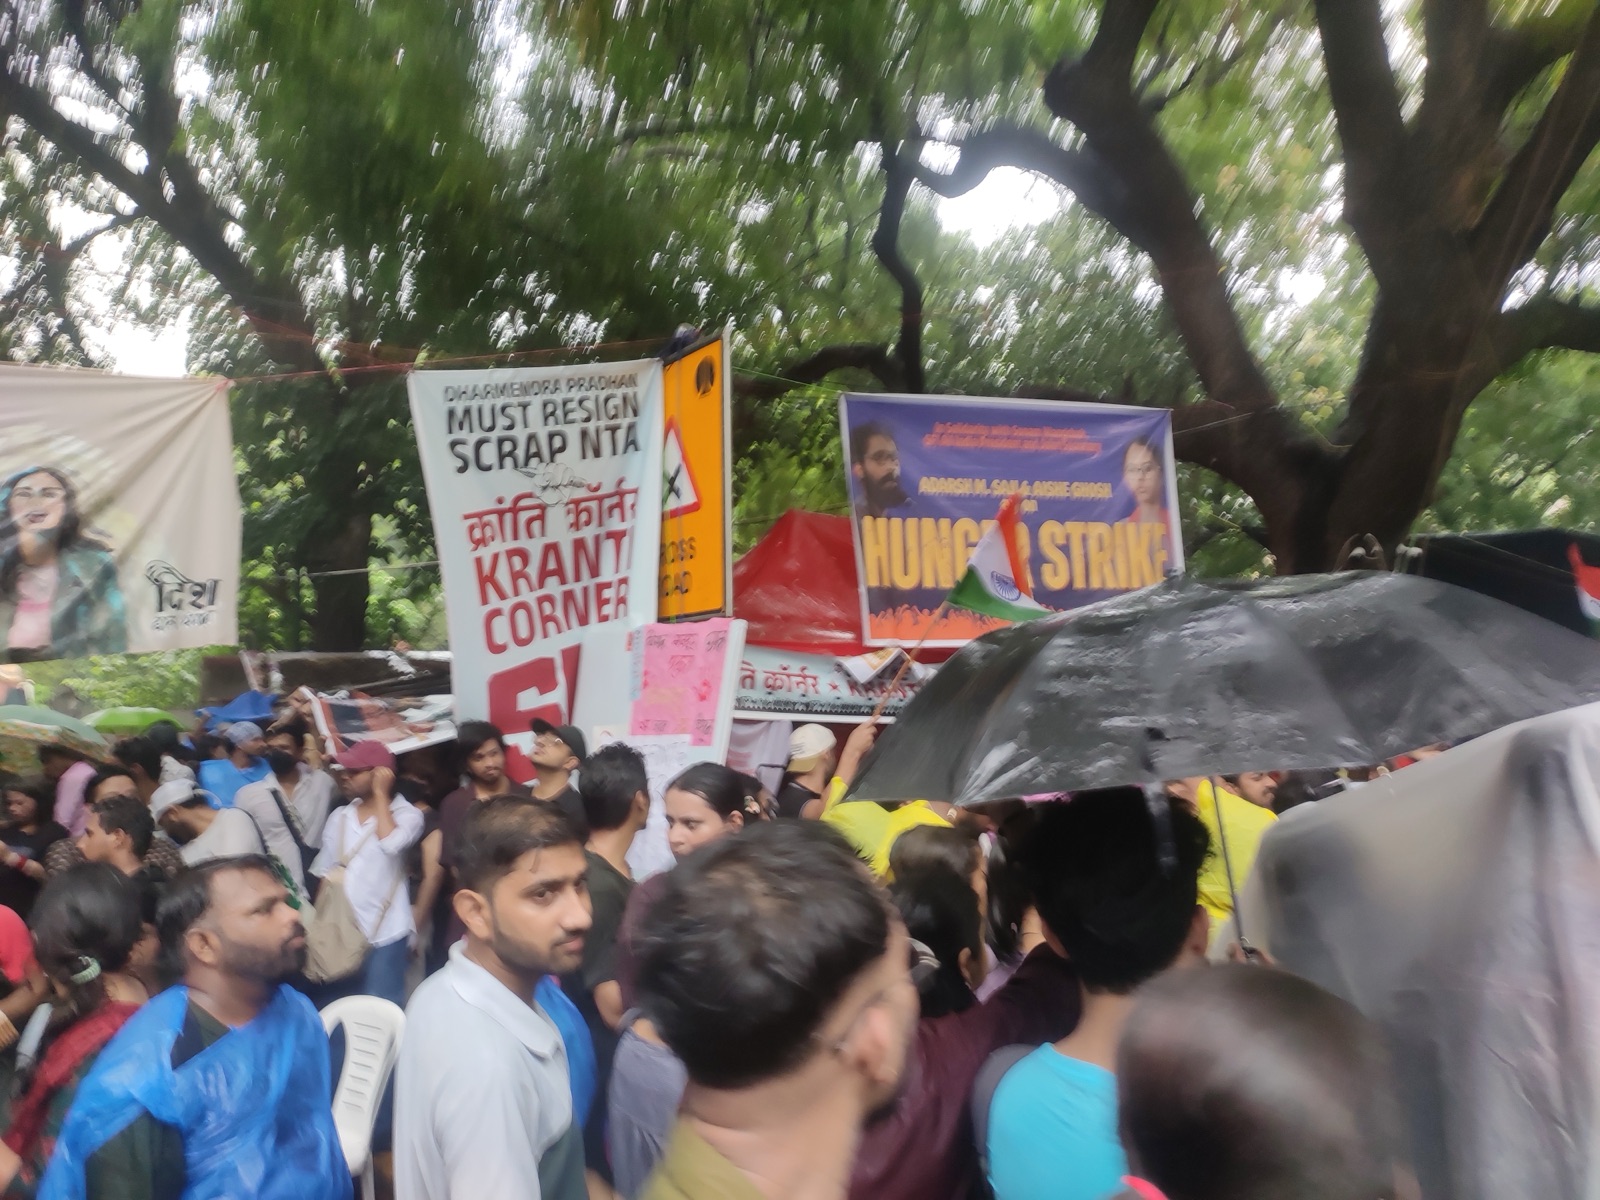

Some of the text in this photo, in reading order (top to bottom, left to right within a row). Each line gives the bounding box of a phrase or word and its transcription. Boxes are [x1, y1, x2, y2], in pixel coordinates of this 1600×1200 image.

[444, 373, 639, 403] DHARMENDRA PRADHAN
[448, 391, 640, 435] MUST RESIGN
[448, 421, 642, 474] SCRAP NTA
[462, 491, 547, 552] क्रांति
[1038, 518, 1169, 591] STRIKE
[484, 576, 629, 655] CORNER
[762, 663, 820, 694] कॉर्नर
